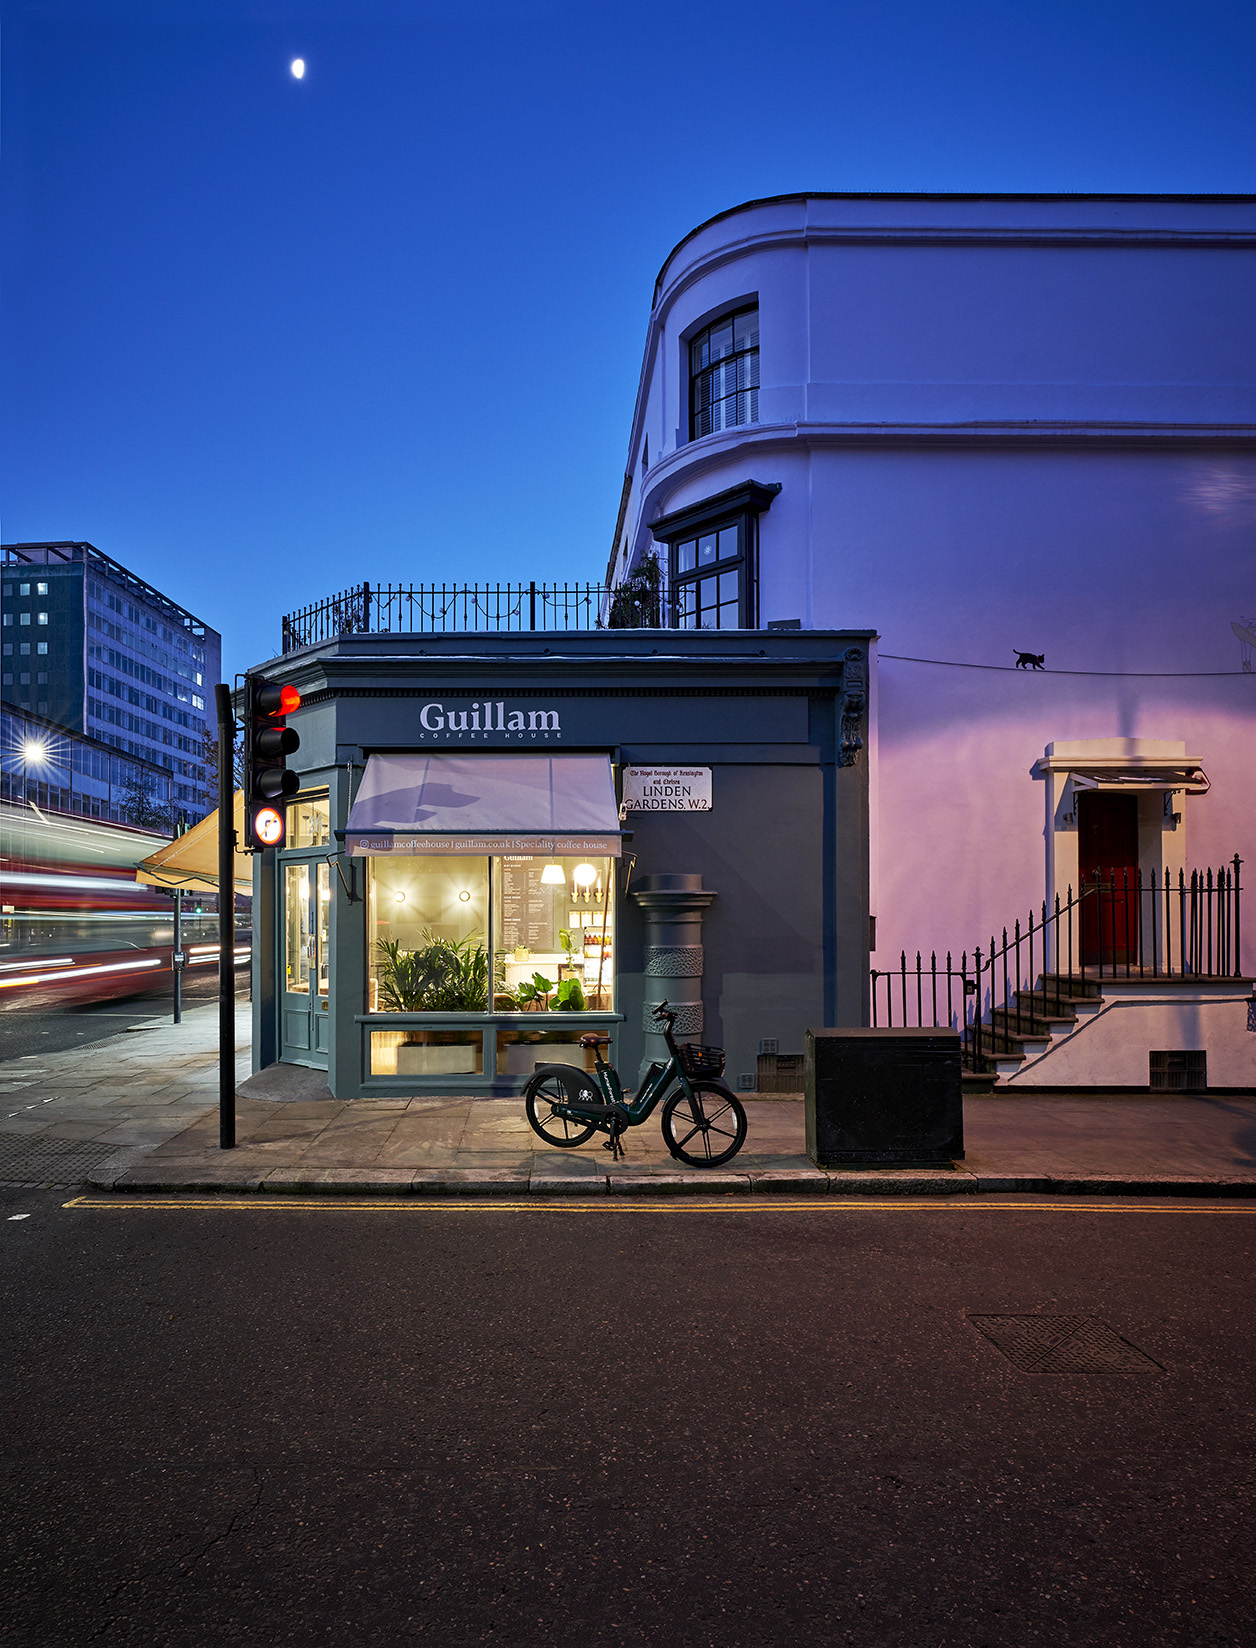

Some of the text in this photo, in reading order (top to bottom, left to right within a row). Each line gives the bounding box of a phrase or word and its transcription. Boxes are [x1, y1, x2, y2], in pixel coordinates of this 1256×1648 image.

[420, 701, 561, 731] Guillam
[640, 770, 653, 778] Royal
[654, 770, 672, 778] Borough
[643, 786, 691, 797] LINDEN
[370, 839, 449, 850] guillamcoffeehouse
[515, 840, 555, 850] Speciality
[556, 840, 582, 849] coffee
[583, 840, 608, 849] house
